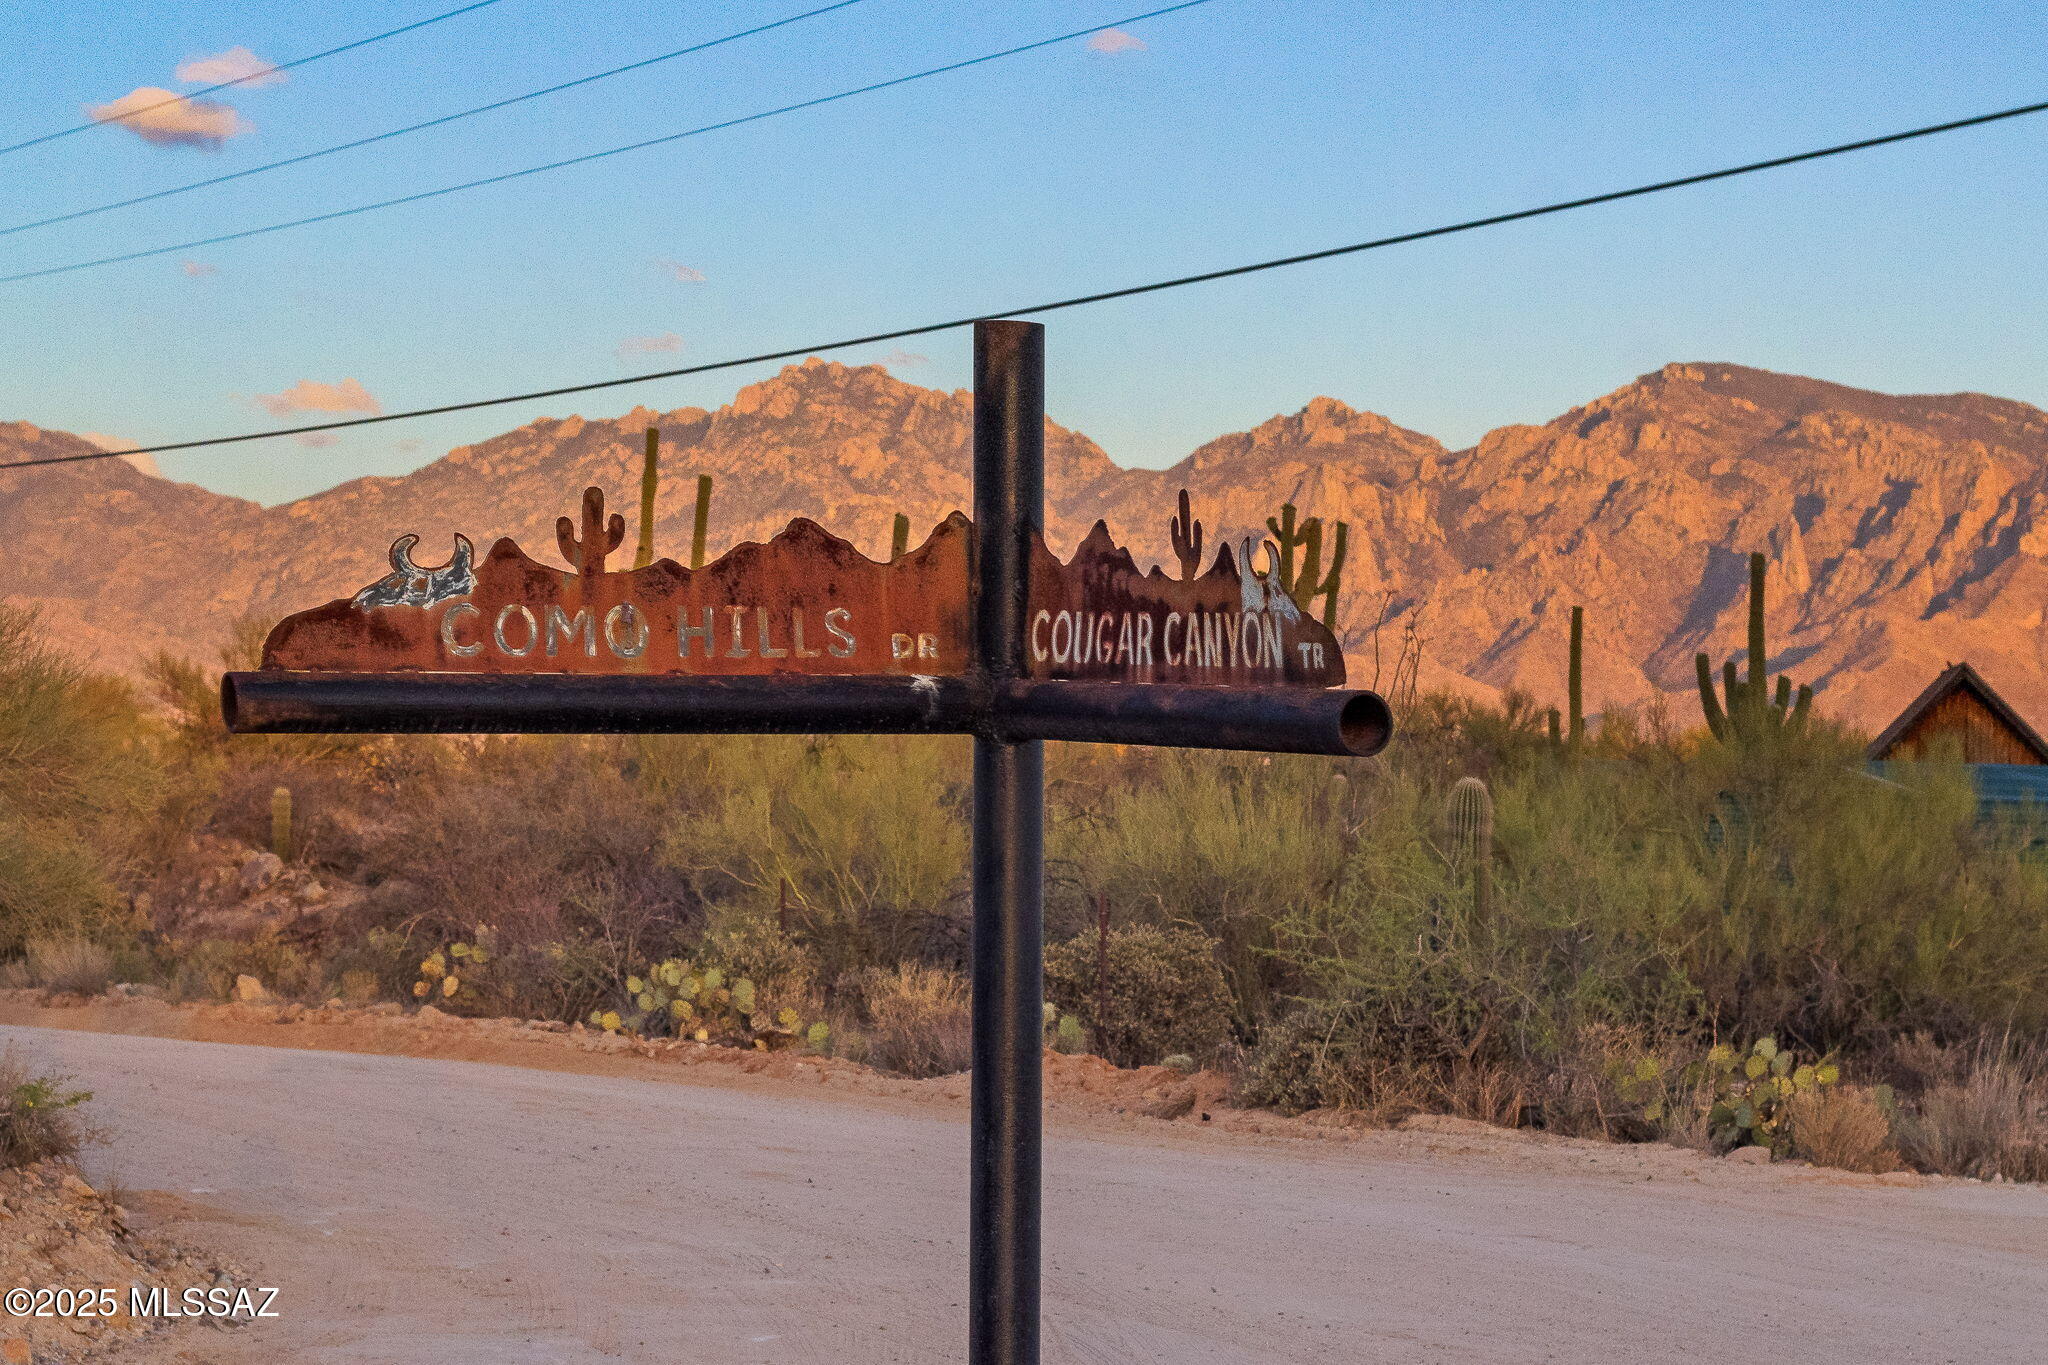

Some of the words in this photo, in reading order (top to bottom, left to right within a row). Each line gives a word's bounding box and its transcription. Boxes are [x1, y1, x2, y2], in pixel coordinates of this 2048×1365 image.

[440, 602, 649, 658] COMO
[677, 605, 857, 658] HILLS
[891, 633, 940, 659] DR
[1031, 609, 1154, 666] COUGAR
[1163, 611, 1284, 669] CANYON
[1298, 642, 1325, 669] TR
